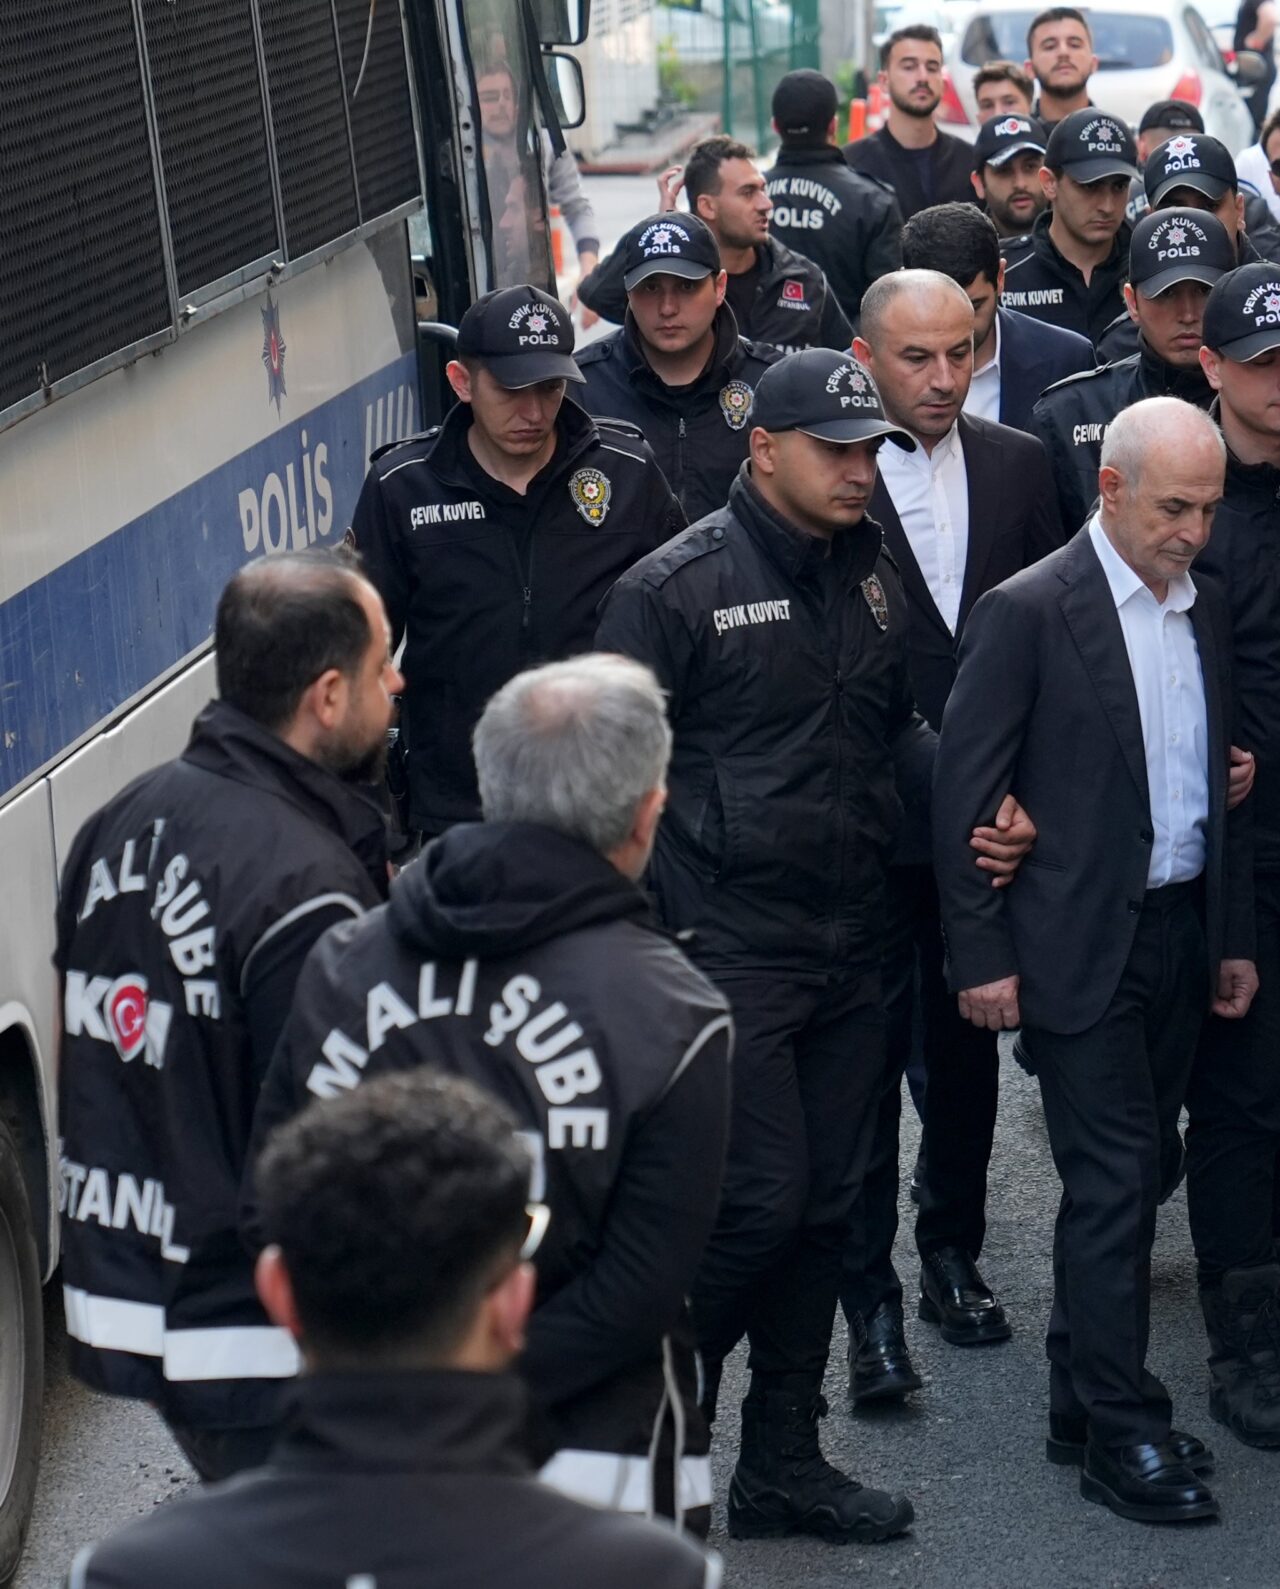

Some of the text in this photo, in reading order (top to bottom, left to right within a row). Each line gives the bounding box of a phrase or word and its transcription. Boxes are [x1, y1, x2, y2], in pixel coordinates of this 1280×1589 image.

[1164, 156, 1201, 174] POLİS
[790, 177, 842, 217] KUVVET
[659, 222, 691, 242] KUVVET
[1171, 217, 1208, 242] KUVVET
[643, 241, 681, 258] POLİS
[1157, 245, 1201, 262] POLİS
[1027, 288, 1064, 306] KUVVET
[531, 303, 560, 328] KUVVET
[238, 428, 334, 556] POLİS
[746, 599, 791, 623] KUVVET
[76, 818, 221, 1020] ALİ ŞUBE
[482, 973, 609, 1150] ŞUBE
